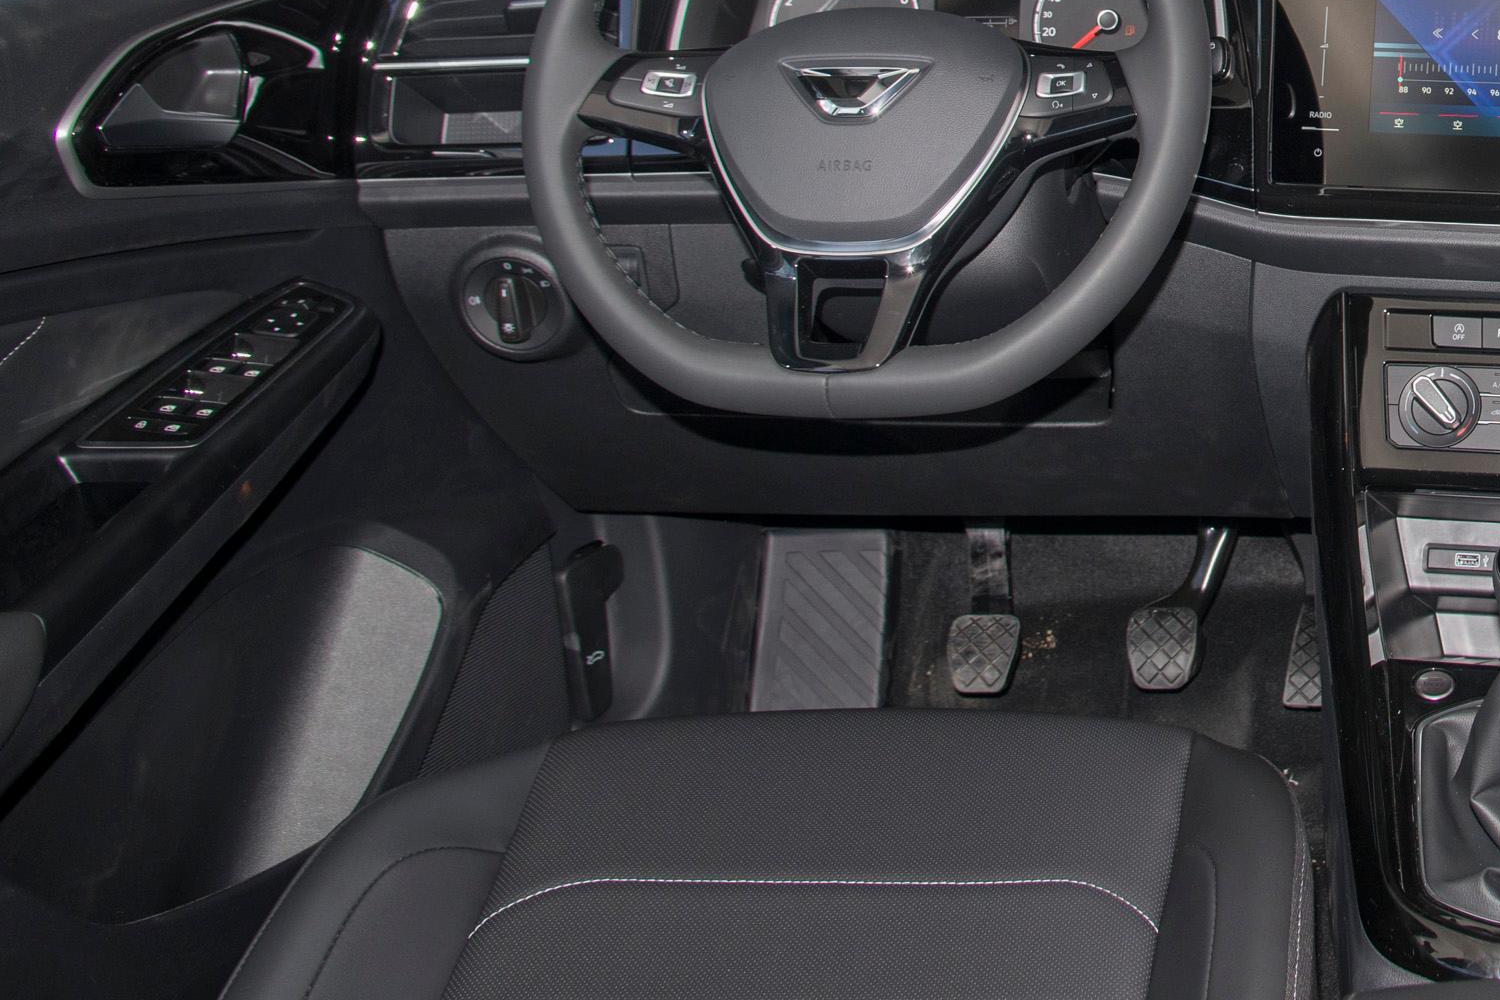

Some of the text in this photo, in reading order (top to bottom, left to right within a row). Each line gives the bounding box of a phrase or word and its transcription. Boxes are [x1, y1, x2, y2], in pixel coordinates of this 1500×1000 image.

[1042, 28, 1056, 36] 20
[1398, 86, 1409, 94] 88
[1421, 86, 1432, 95] 90
[1444, 87, 1454, 96] 92
[1466, 88, 1477, 96] 94
[1490, 89, 1500, 97] 96
[1309, 111, 1332, 119] RADIO
[817, 159, 873, 172] AIRBAG
[1452, 333, 1465, 341] OFF
